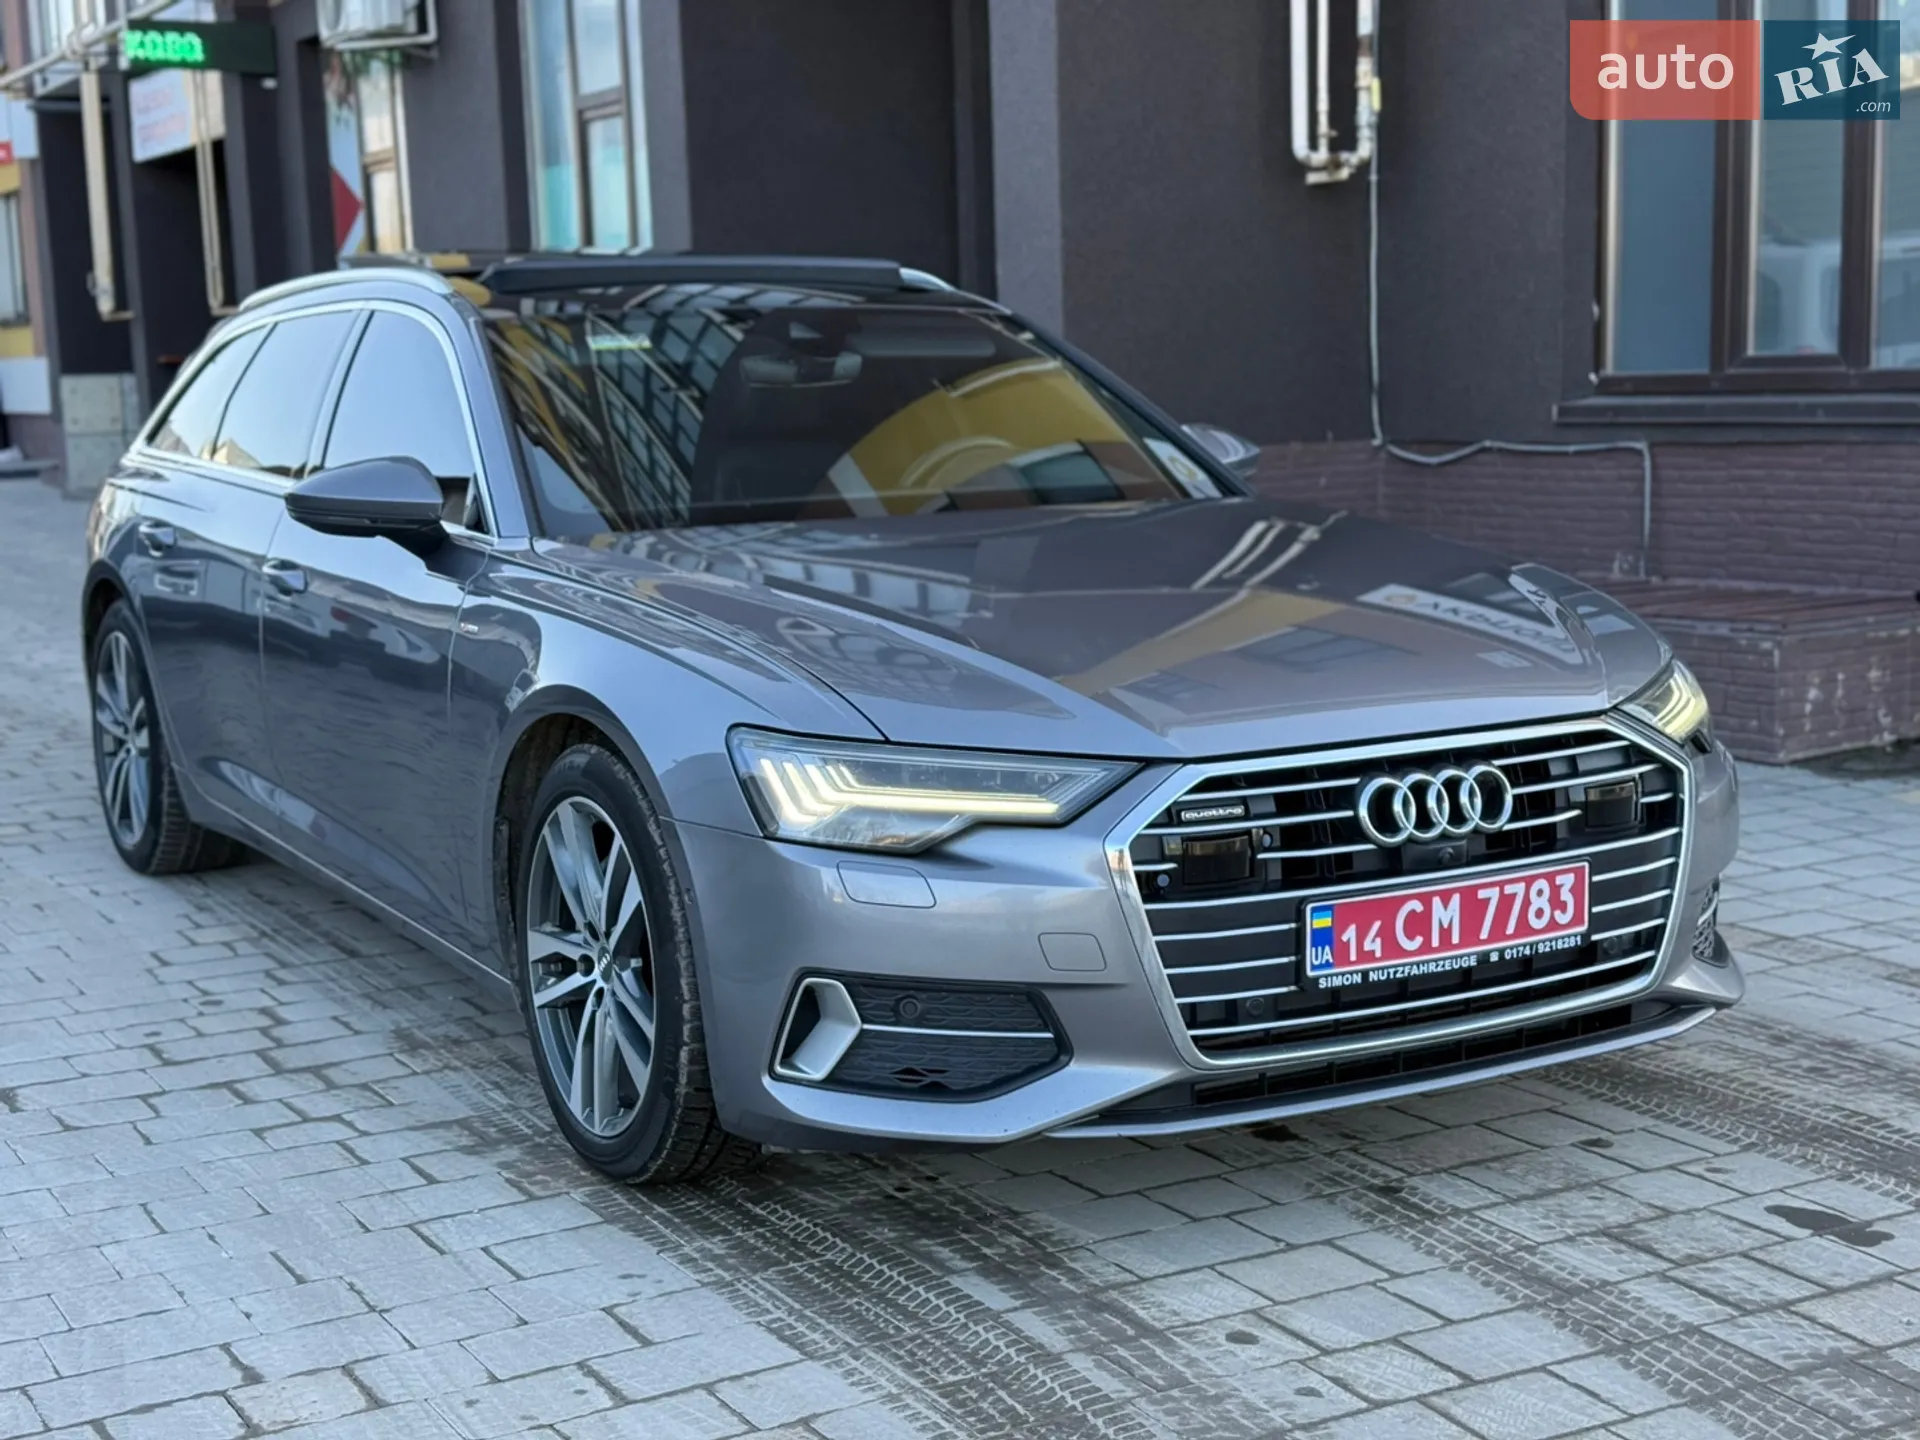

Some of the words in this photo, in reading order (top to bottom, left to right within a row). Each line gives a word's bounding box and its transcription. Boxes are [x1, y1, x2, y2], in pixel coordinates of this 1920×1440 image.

[1184, 807, 1243, 820] quattro
[1341, 920, 1382, 962] 14
[1395, 892, 1461, 951] CM
[1477, 872, 1576, 940] 7783
[1311, 945, 1333, 965] UA
[1318, 971, 1362, 989] SIMON
[1368, 955, 1478, 983] NUTZFAHRZEUGE
